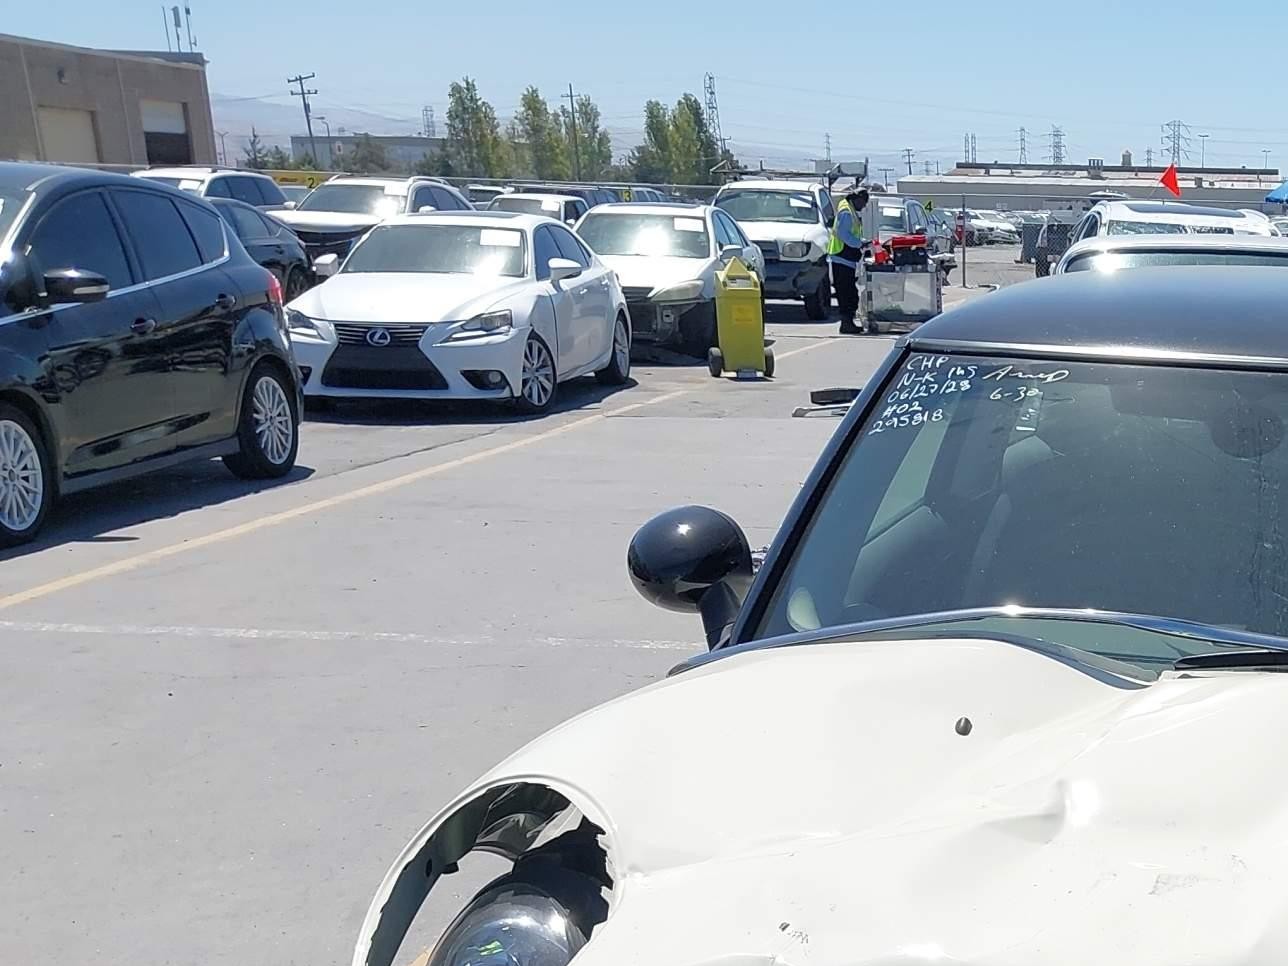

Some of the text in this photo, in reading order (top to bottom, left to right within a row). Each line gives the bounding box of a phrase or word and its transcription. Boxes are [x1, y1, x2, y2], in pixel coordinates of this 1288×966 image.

[307, 177, 316, 189] 2
[624, 190, 632, 203] 3
[924, 200, 933, 213] 4
[906, 355, 949, 371] CHP
[881, 400, 923, 419] #02
